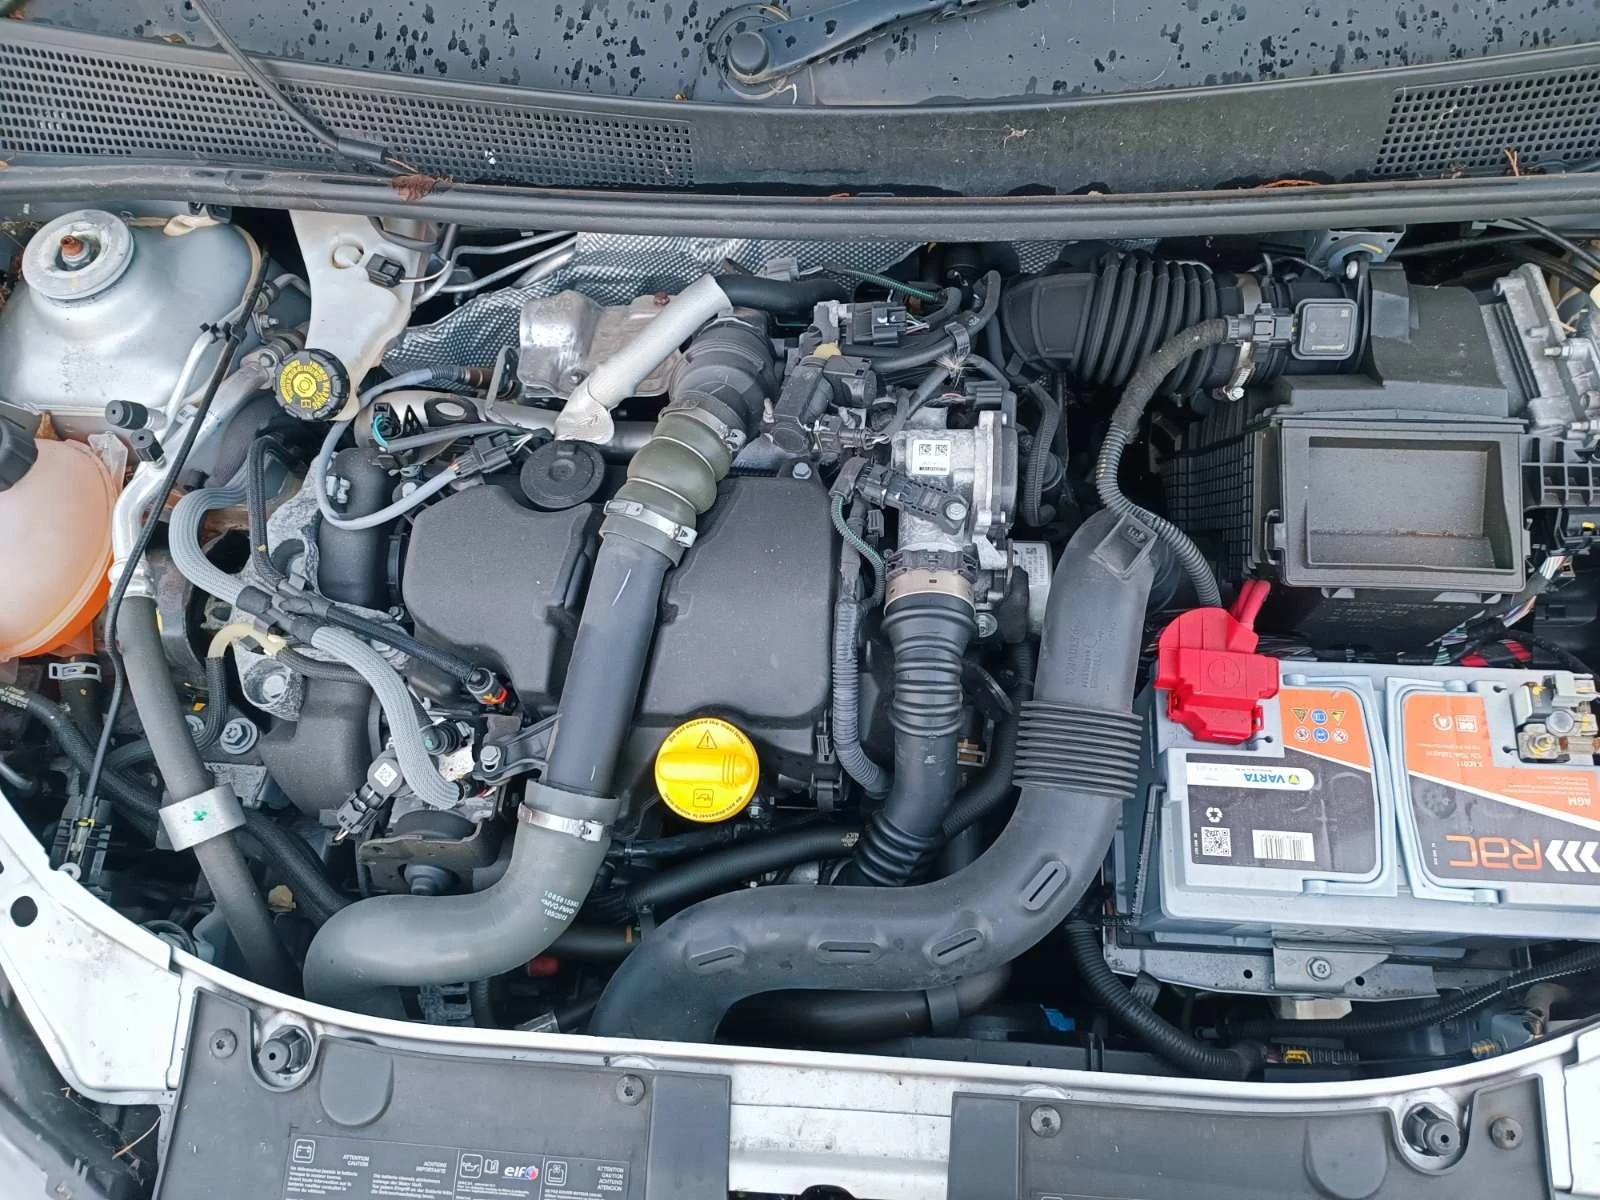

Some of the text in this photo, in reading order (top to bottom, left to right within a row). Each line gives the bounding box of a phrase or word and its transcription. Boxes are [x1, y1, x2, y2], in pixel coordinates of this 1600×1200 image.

[686, 719, 708, 728] exceed
[1244, 773, 1286, 784] VARTA
[1567, 796, 1592, 806] AGM
[504, 1165, 526, 1177] elf
